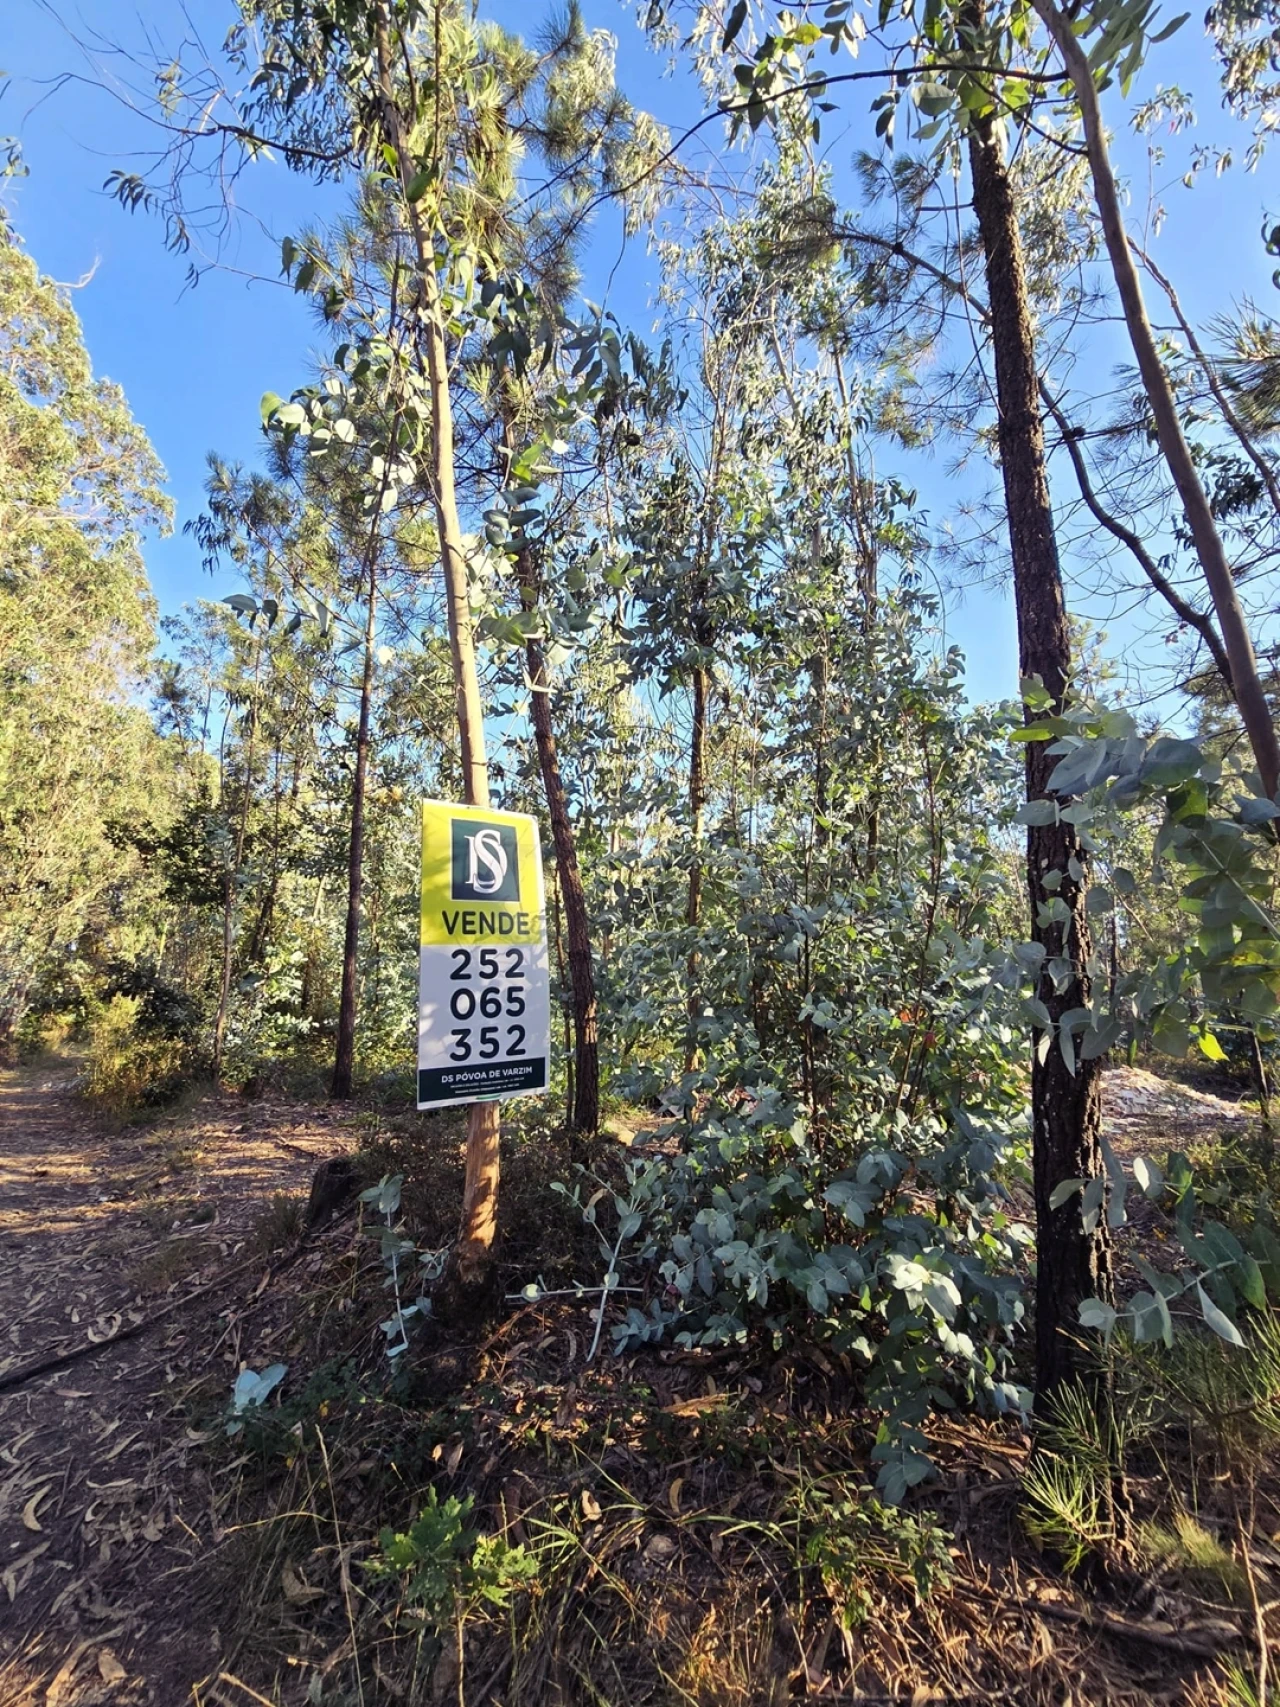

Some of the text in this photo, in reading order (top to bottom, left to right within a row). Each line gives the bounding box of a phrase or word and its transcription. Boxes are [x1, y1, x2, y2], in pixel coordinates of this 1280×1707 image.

[442, 911, 531, 936] VENDE
[450, 948, 525, 981] 252
[450, 986, 526, 1021] 065
[450, 1024, 526, 1062] 352
[441, 1075, 454, 1083] DS
[455, 1071, 487, 1082] PÓVOA
[489, 1070, 501, 1078] DE
[502, 1066, 532, 1077] VARZIM
